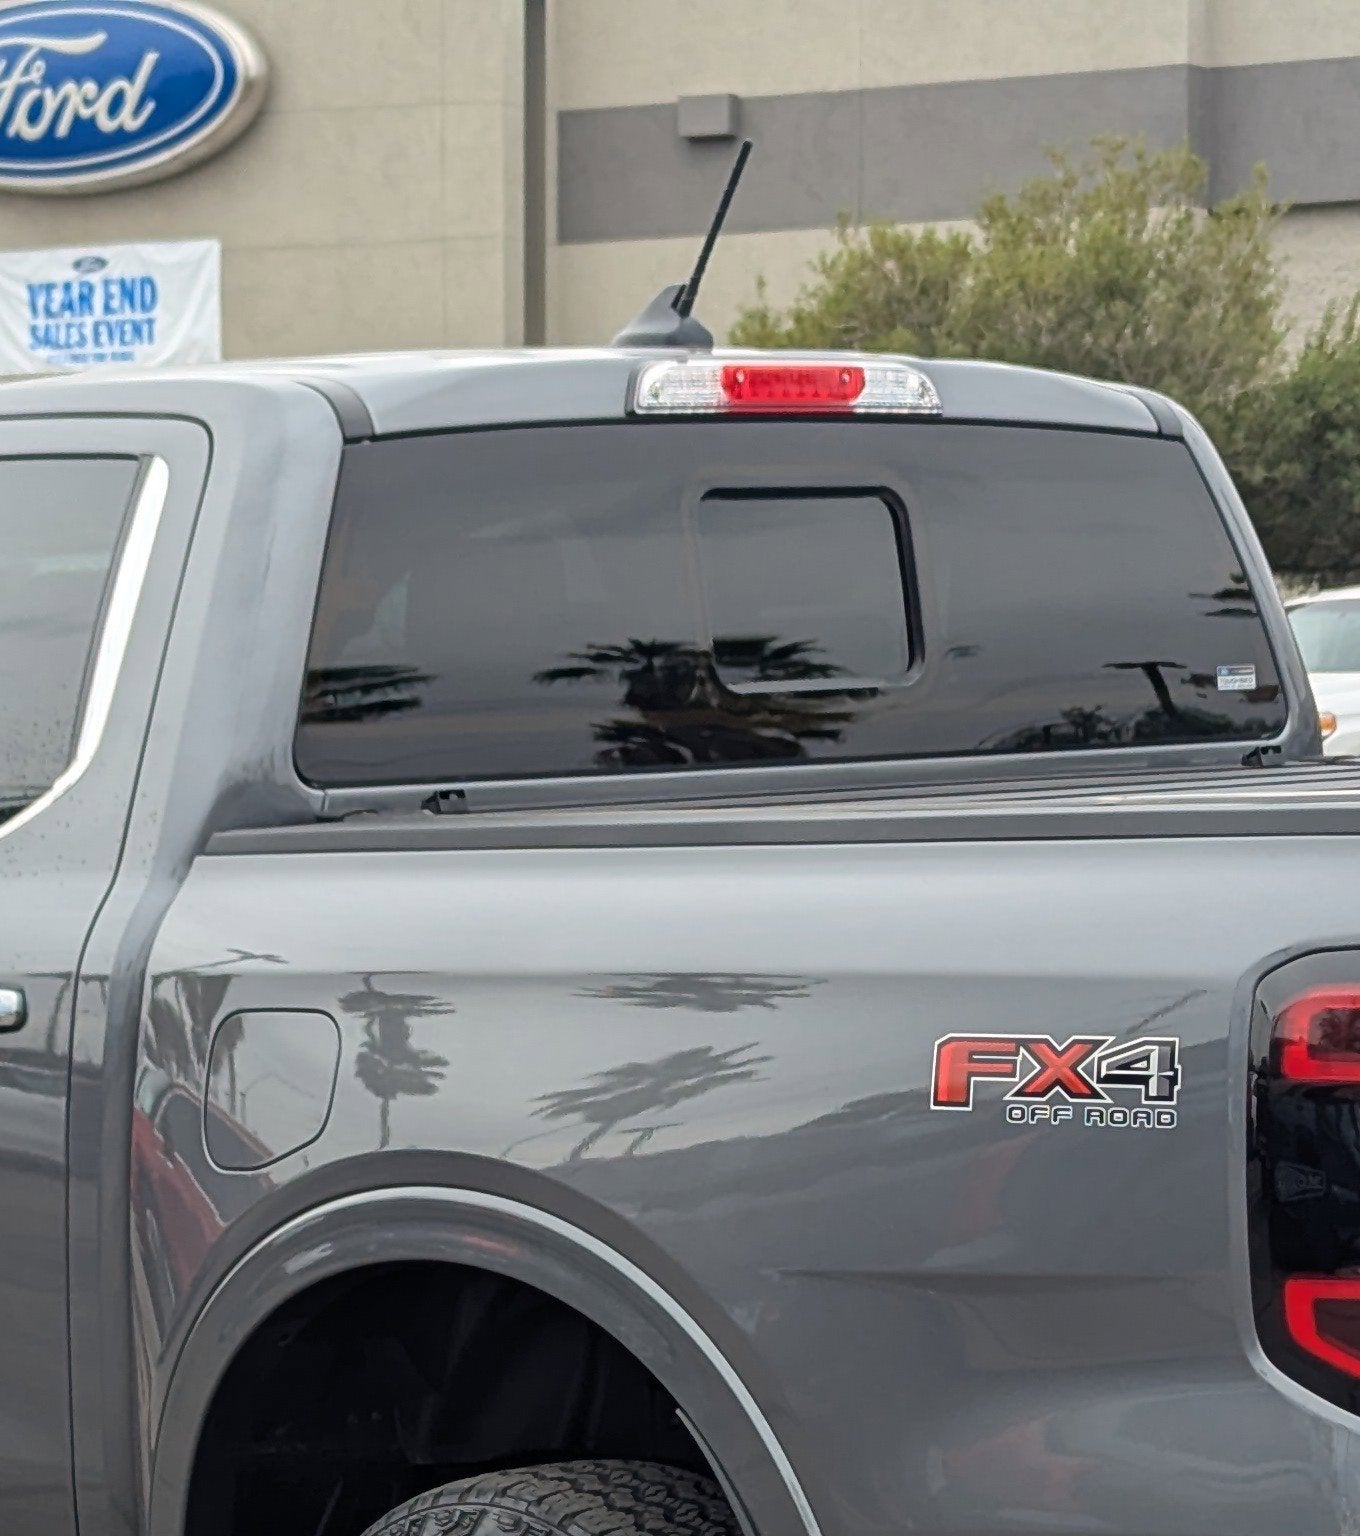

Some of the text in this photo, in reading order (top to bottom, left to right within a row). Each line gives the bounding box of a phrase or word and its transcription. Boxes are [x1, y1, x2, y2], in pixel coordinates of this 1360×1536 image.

[27, 276, 158, 319] YEAR END
[30, 318, 156, 350] SALES EVENT
[930, 1033, 1181, 1111] FX4
[1006, 1104, 1177, 1129] OFF ROAD
